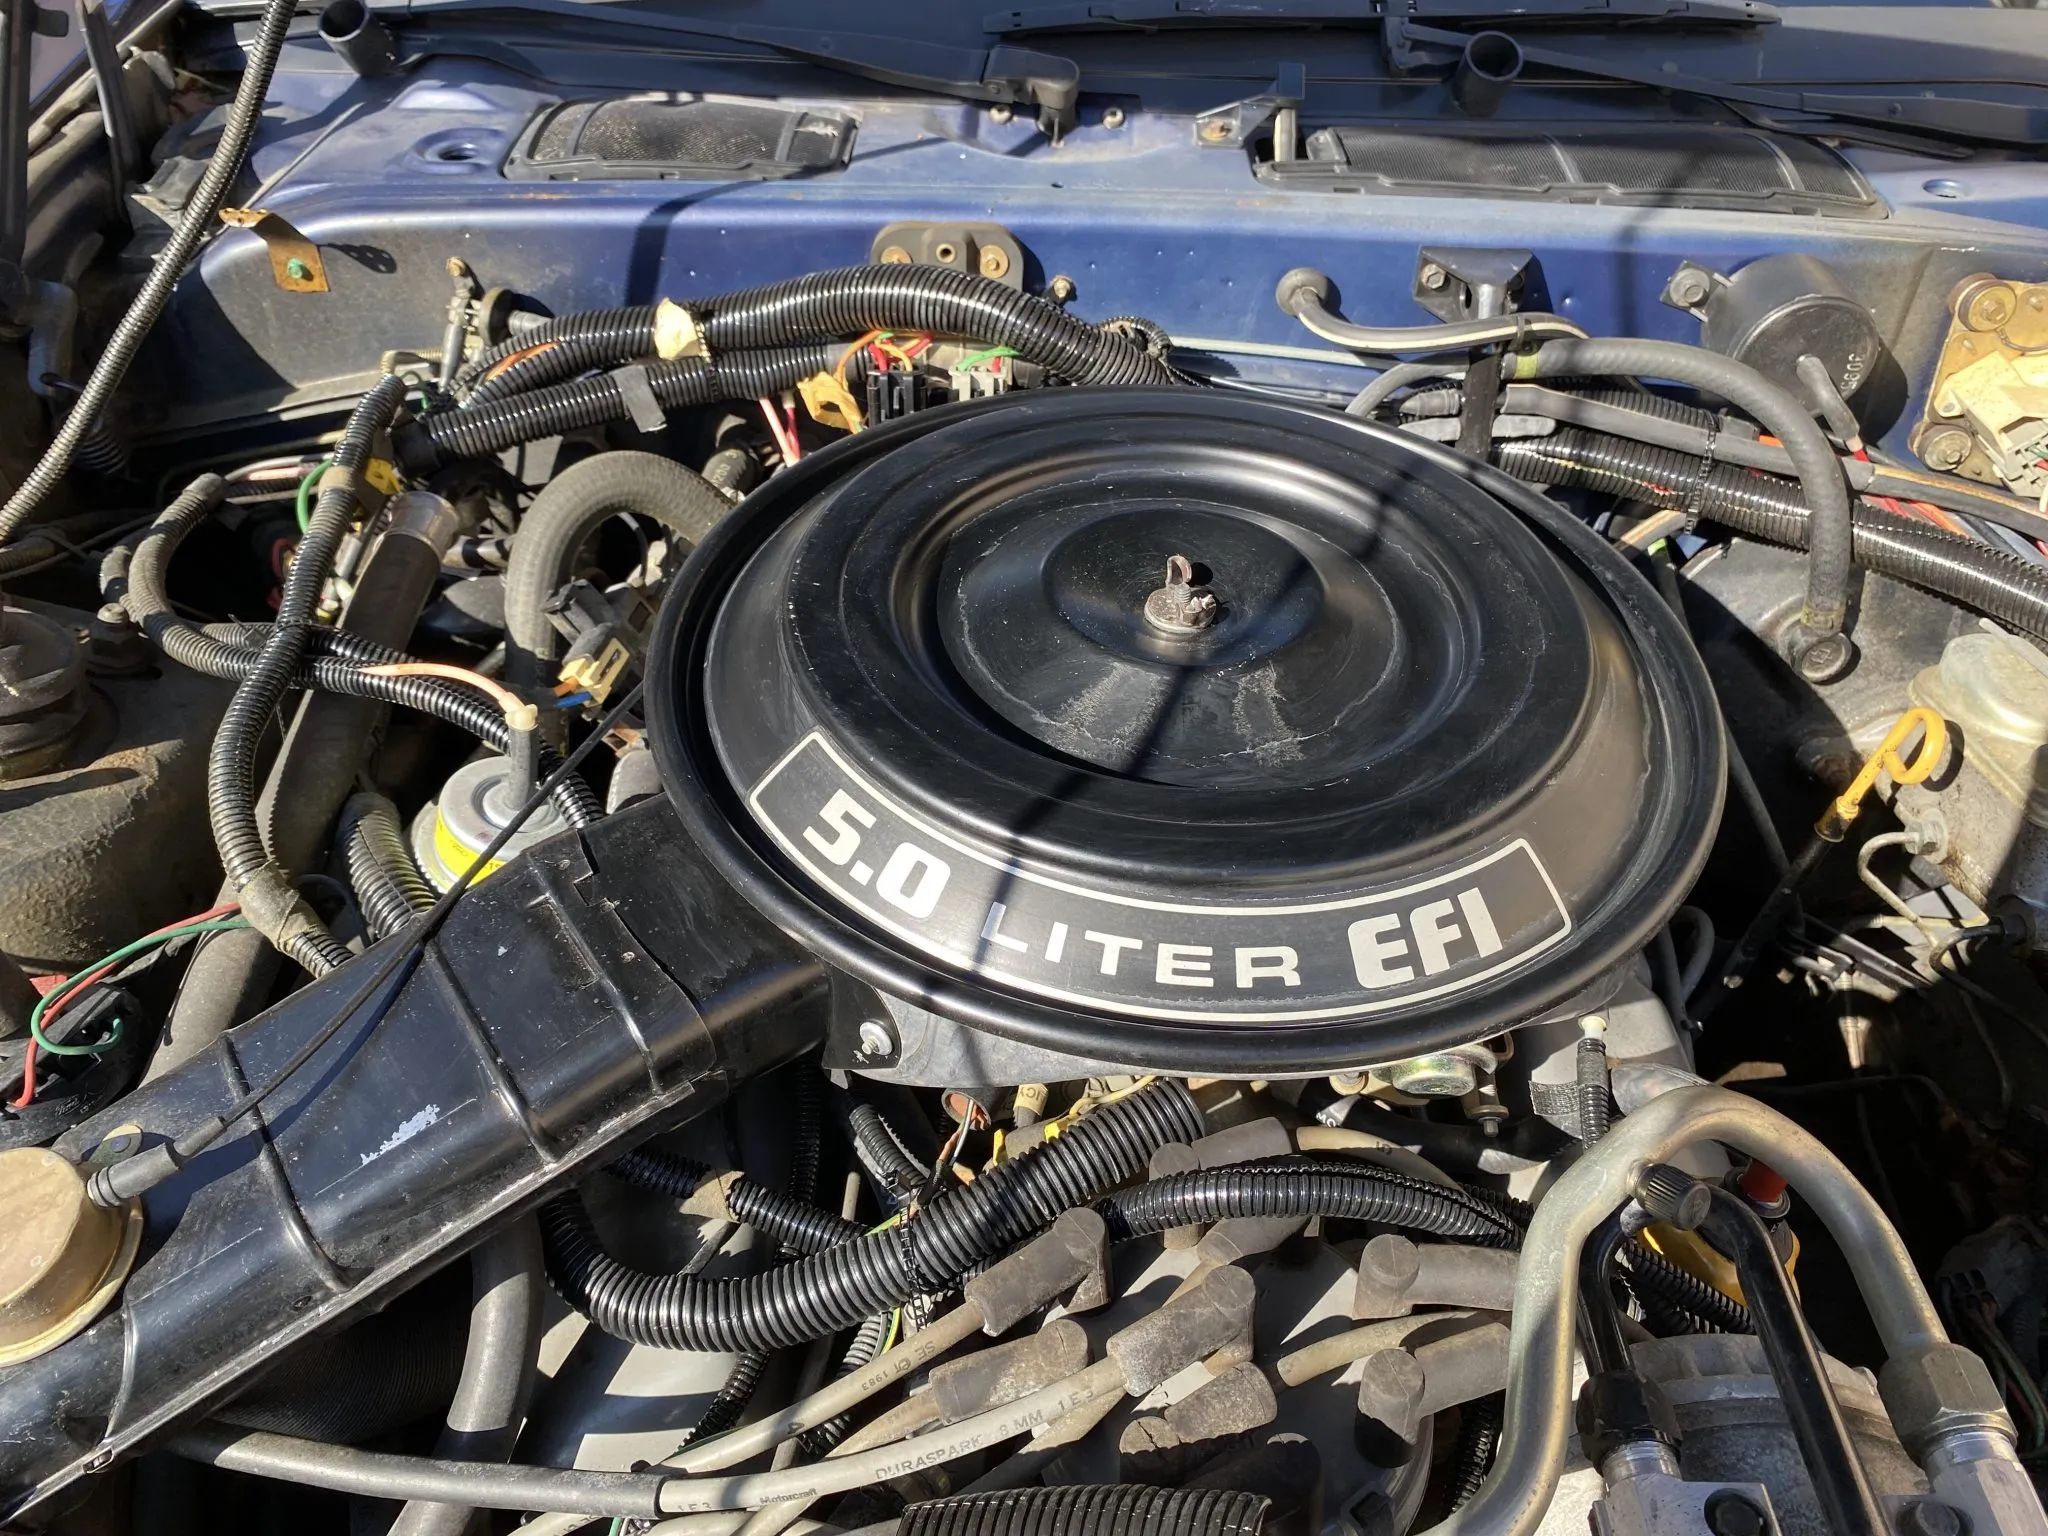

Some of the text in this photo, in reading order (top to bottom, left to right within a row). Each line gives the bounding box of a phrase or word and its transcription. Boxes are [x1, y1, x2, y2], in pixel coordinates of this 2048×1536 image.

[803, 789, 1503, 990] 5.0 LITER EFI
[861, 1370, 890, 1391] 1983
[875, 1433, 984, 1481] DURASPARK
[999, 1424, 1008, 1437] 8
[1014, 1409, 1044, 1430] MM
[759, 1487, 818, 1505] Motorcraft
